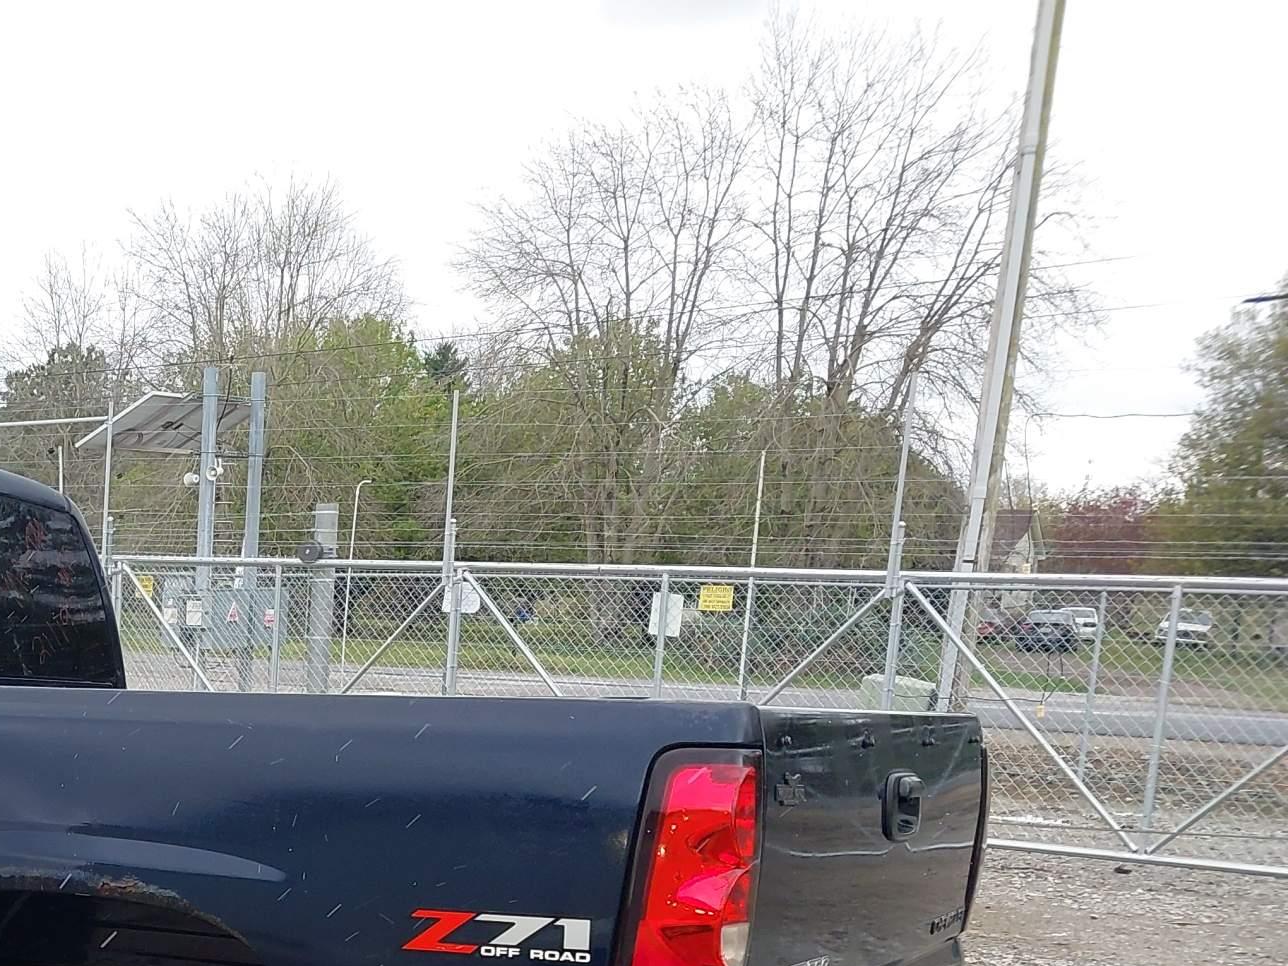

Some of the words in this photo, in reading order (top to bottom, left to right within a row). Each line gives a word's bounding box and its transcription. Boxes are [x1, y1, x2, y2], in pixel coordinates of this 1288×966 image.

[402, 908, 591, 954] Z71
[480, 946, 520, 958] OFF
[530, 949, 591, 963] ROAD
